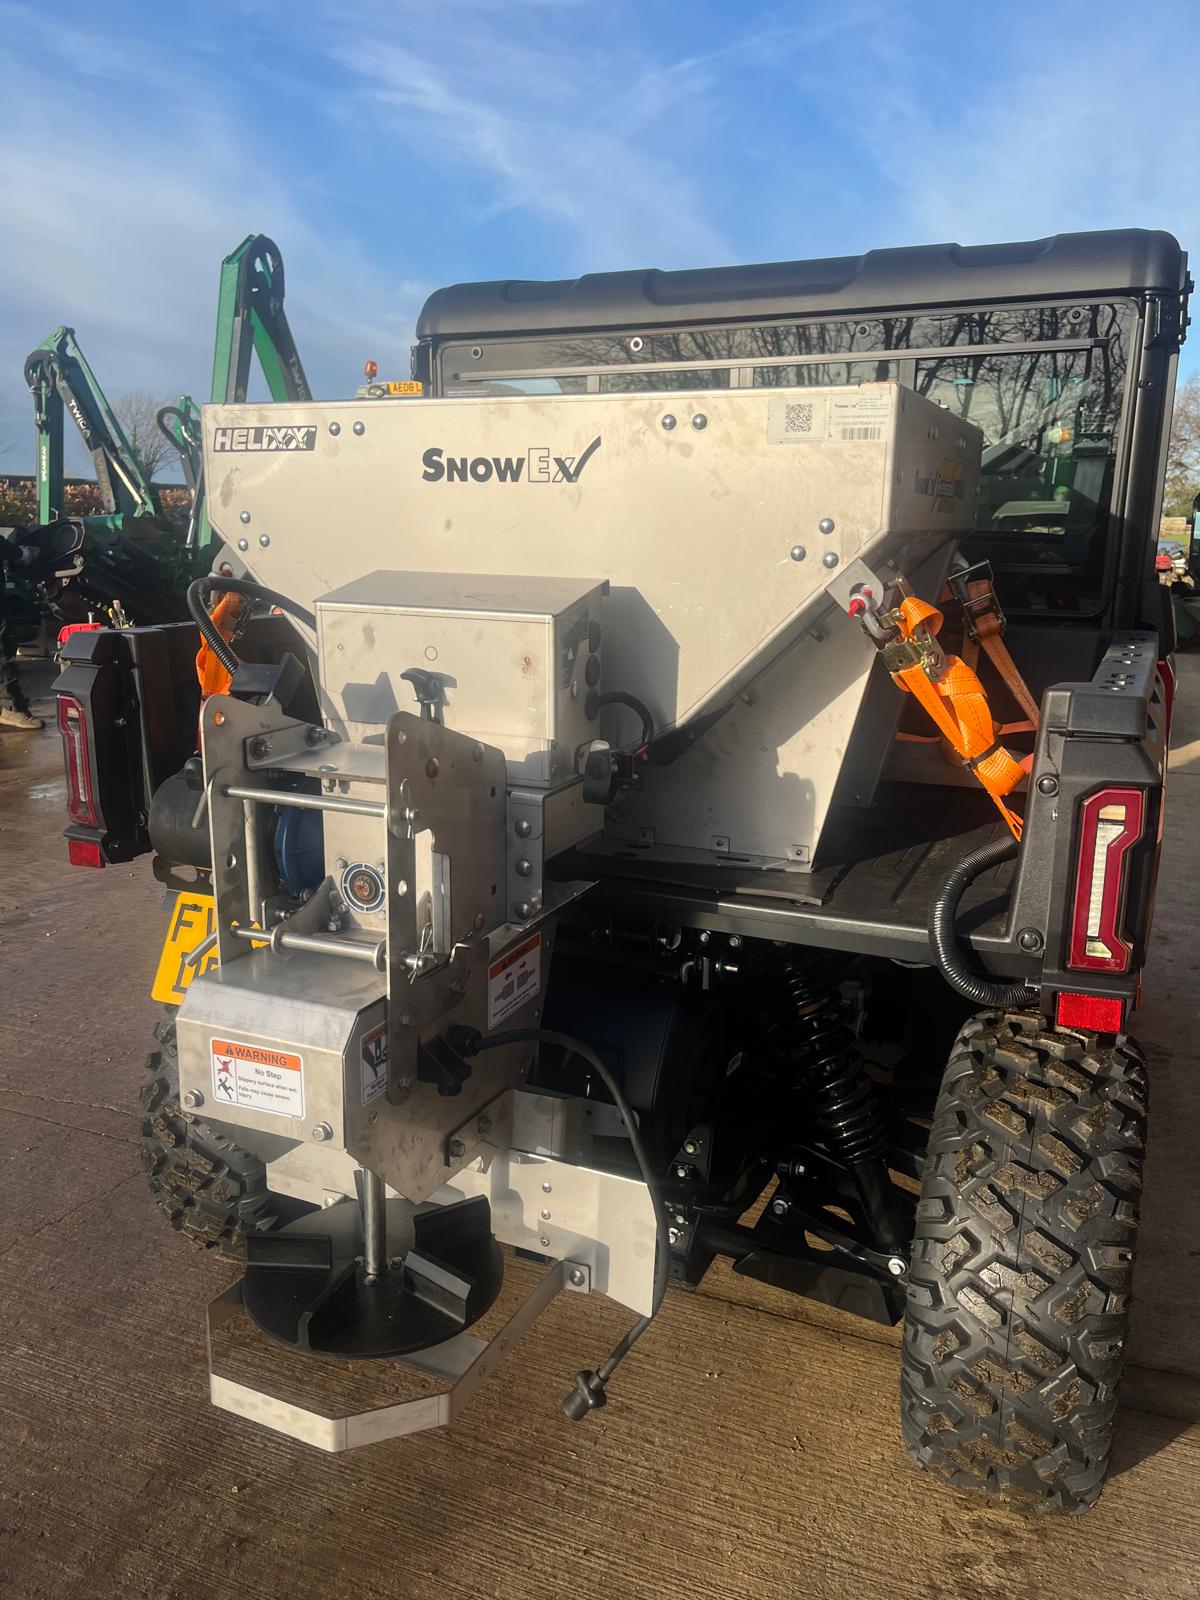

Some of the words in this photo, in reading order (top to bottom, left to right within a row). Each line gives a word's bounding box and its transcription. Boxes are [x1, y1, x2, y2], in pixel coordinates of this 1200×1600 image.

[235, 1047, 288, 1067] WARNING
[254, 1068, 265, 1077] No
[266, 1070, 282, 1081] Step
[257, 1080, 275, 1088] surface
